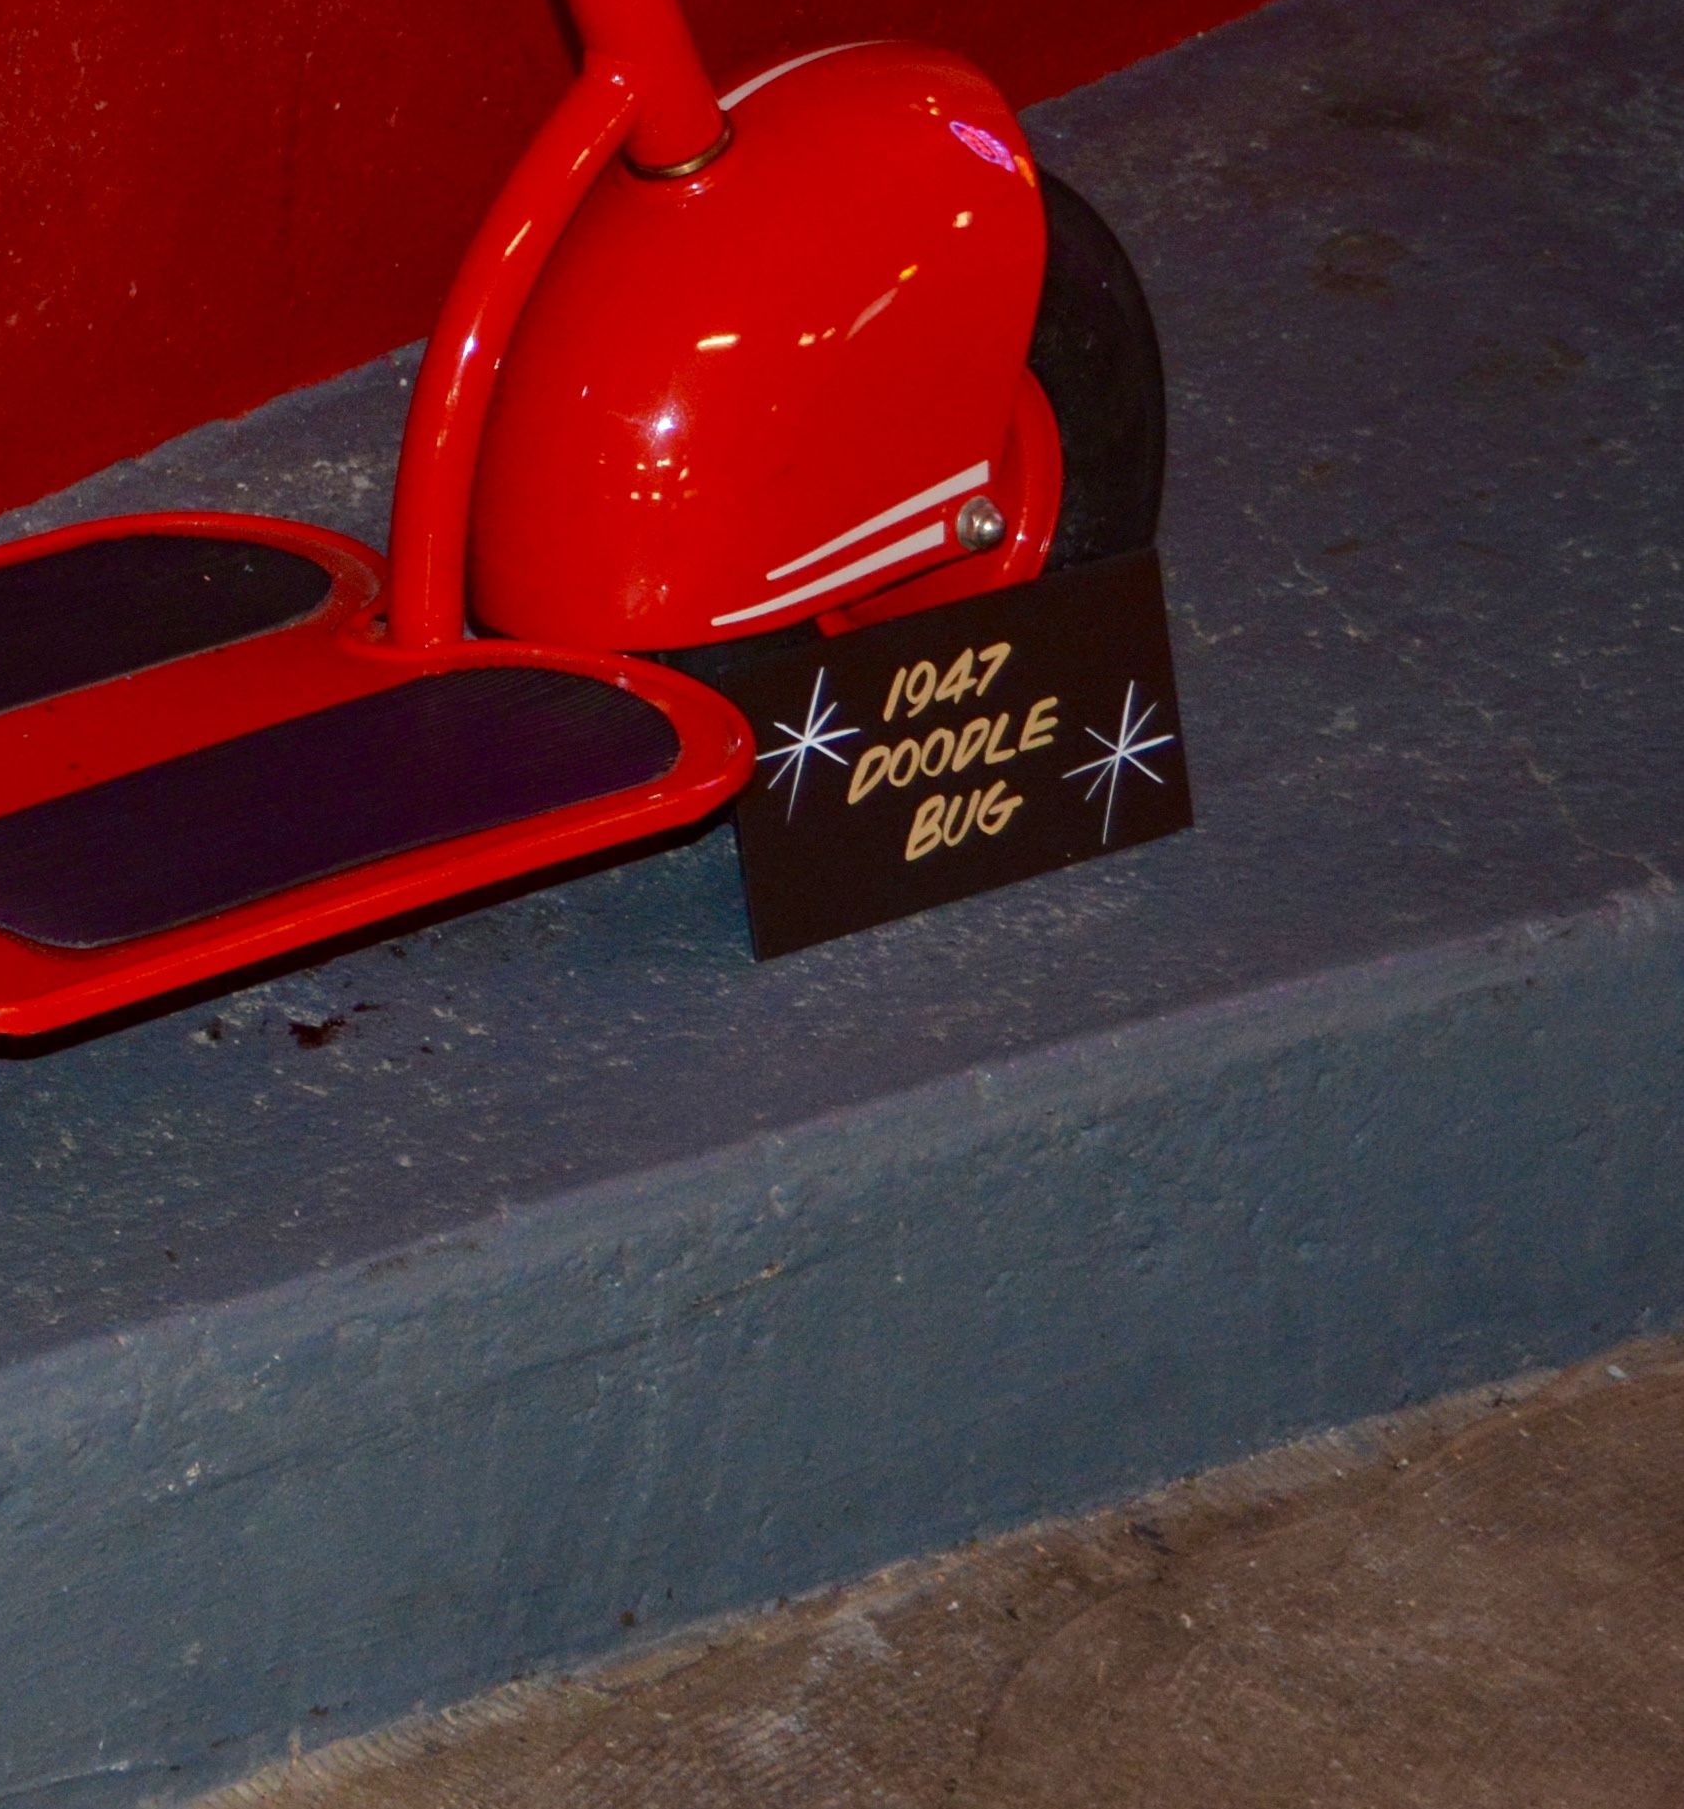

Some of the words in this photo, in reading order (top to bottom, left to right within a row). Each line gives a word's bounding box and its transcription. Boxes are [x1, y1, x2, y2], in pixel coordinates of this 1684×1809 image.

[883, 642, 1011, 722] 1947
[847, 696, 1060, 805] DOODLE
[904, 780, 1024, 862] BUG
